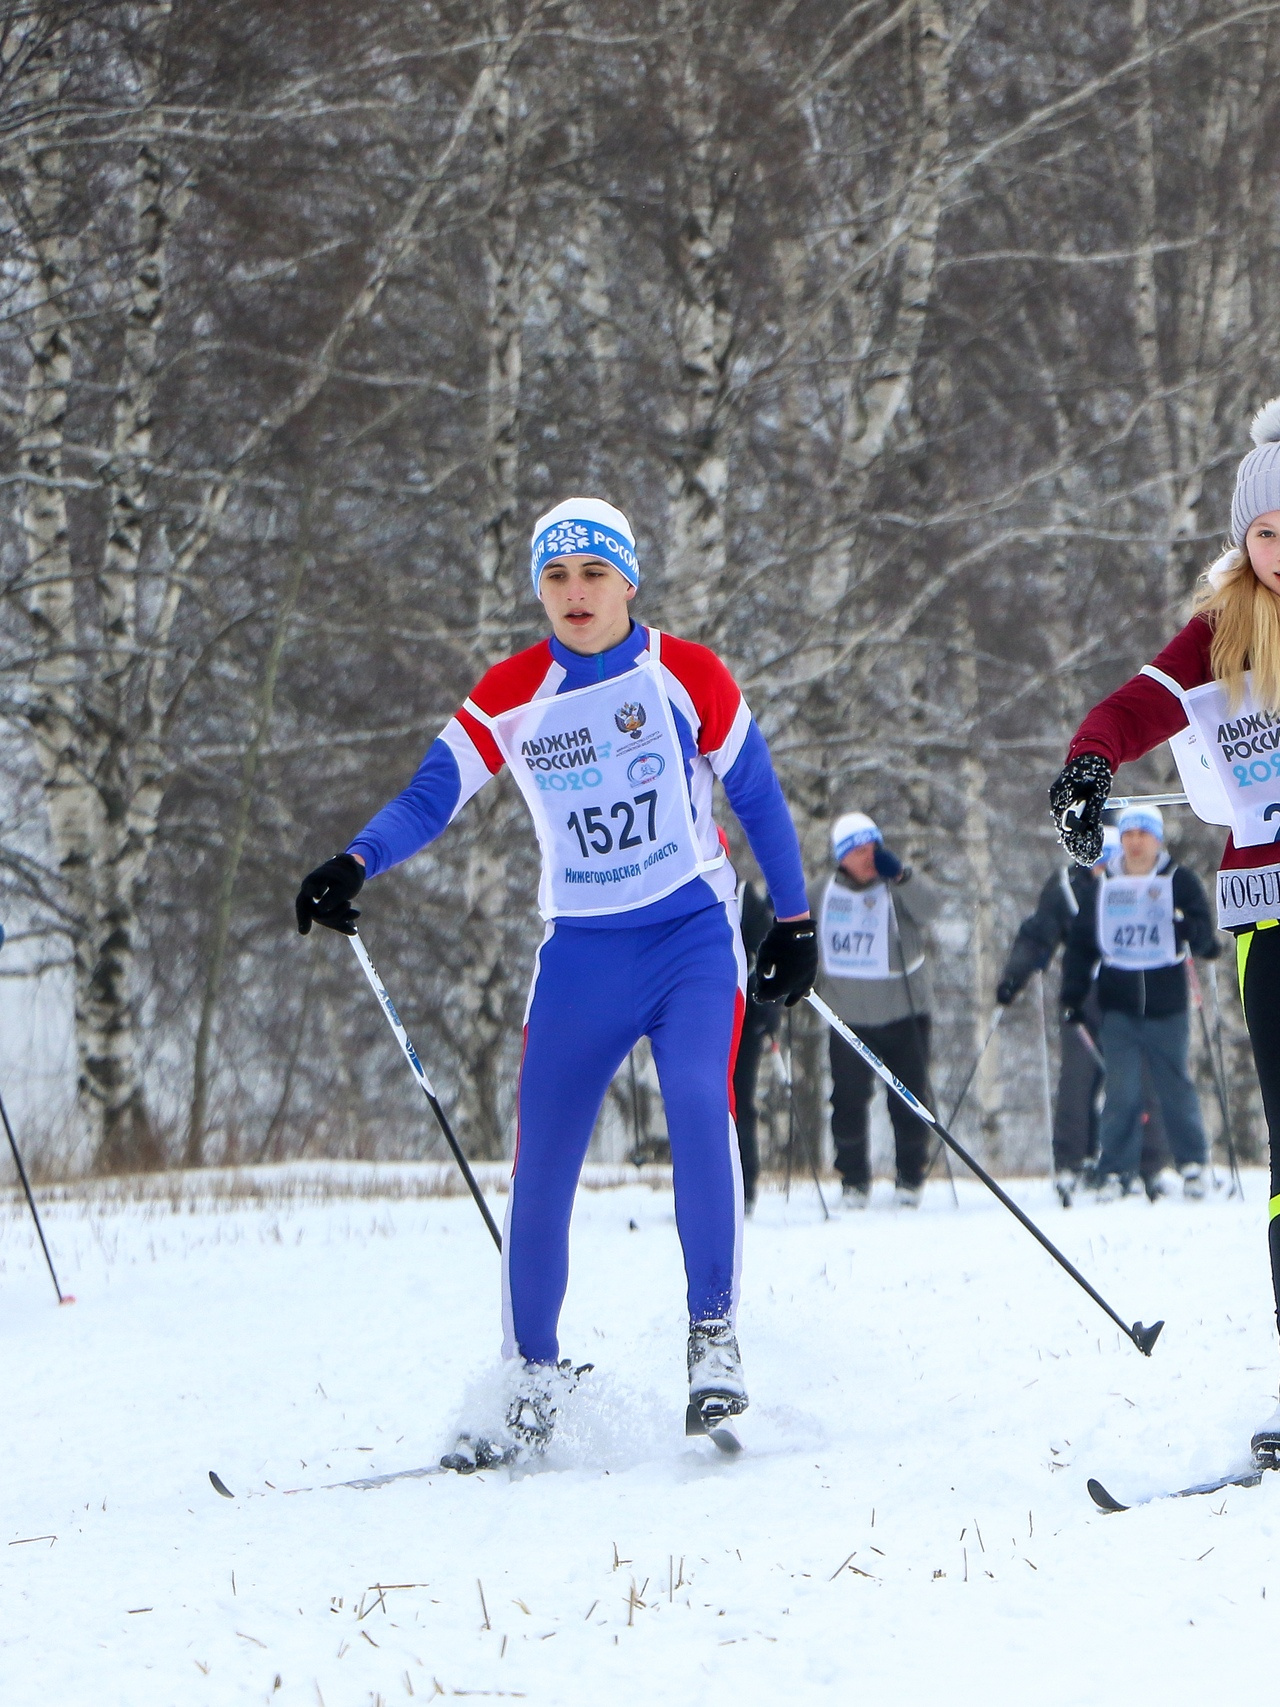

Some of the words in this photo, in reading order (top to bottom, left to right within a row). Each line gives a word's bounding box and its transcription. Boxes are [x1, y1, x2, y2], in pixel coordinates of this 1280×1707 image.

[521, 726, 593, 756] ЛЫЖНЯ
[525, 745, 598, 771] РОССИИ
[535, 767, 603, 792] 2020
[567, 789, 658, 858] 1527
[565, 864, 642, 886] Нижегородская
[643, 841, 679, 870] область
[831, 931, 876, 956] 6477
[1113, 923, 1160, 948] 4274
